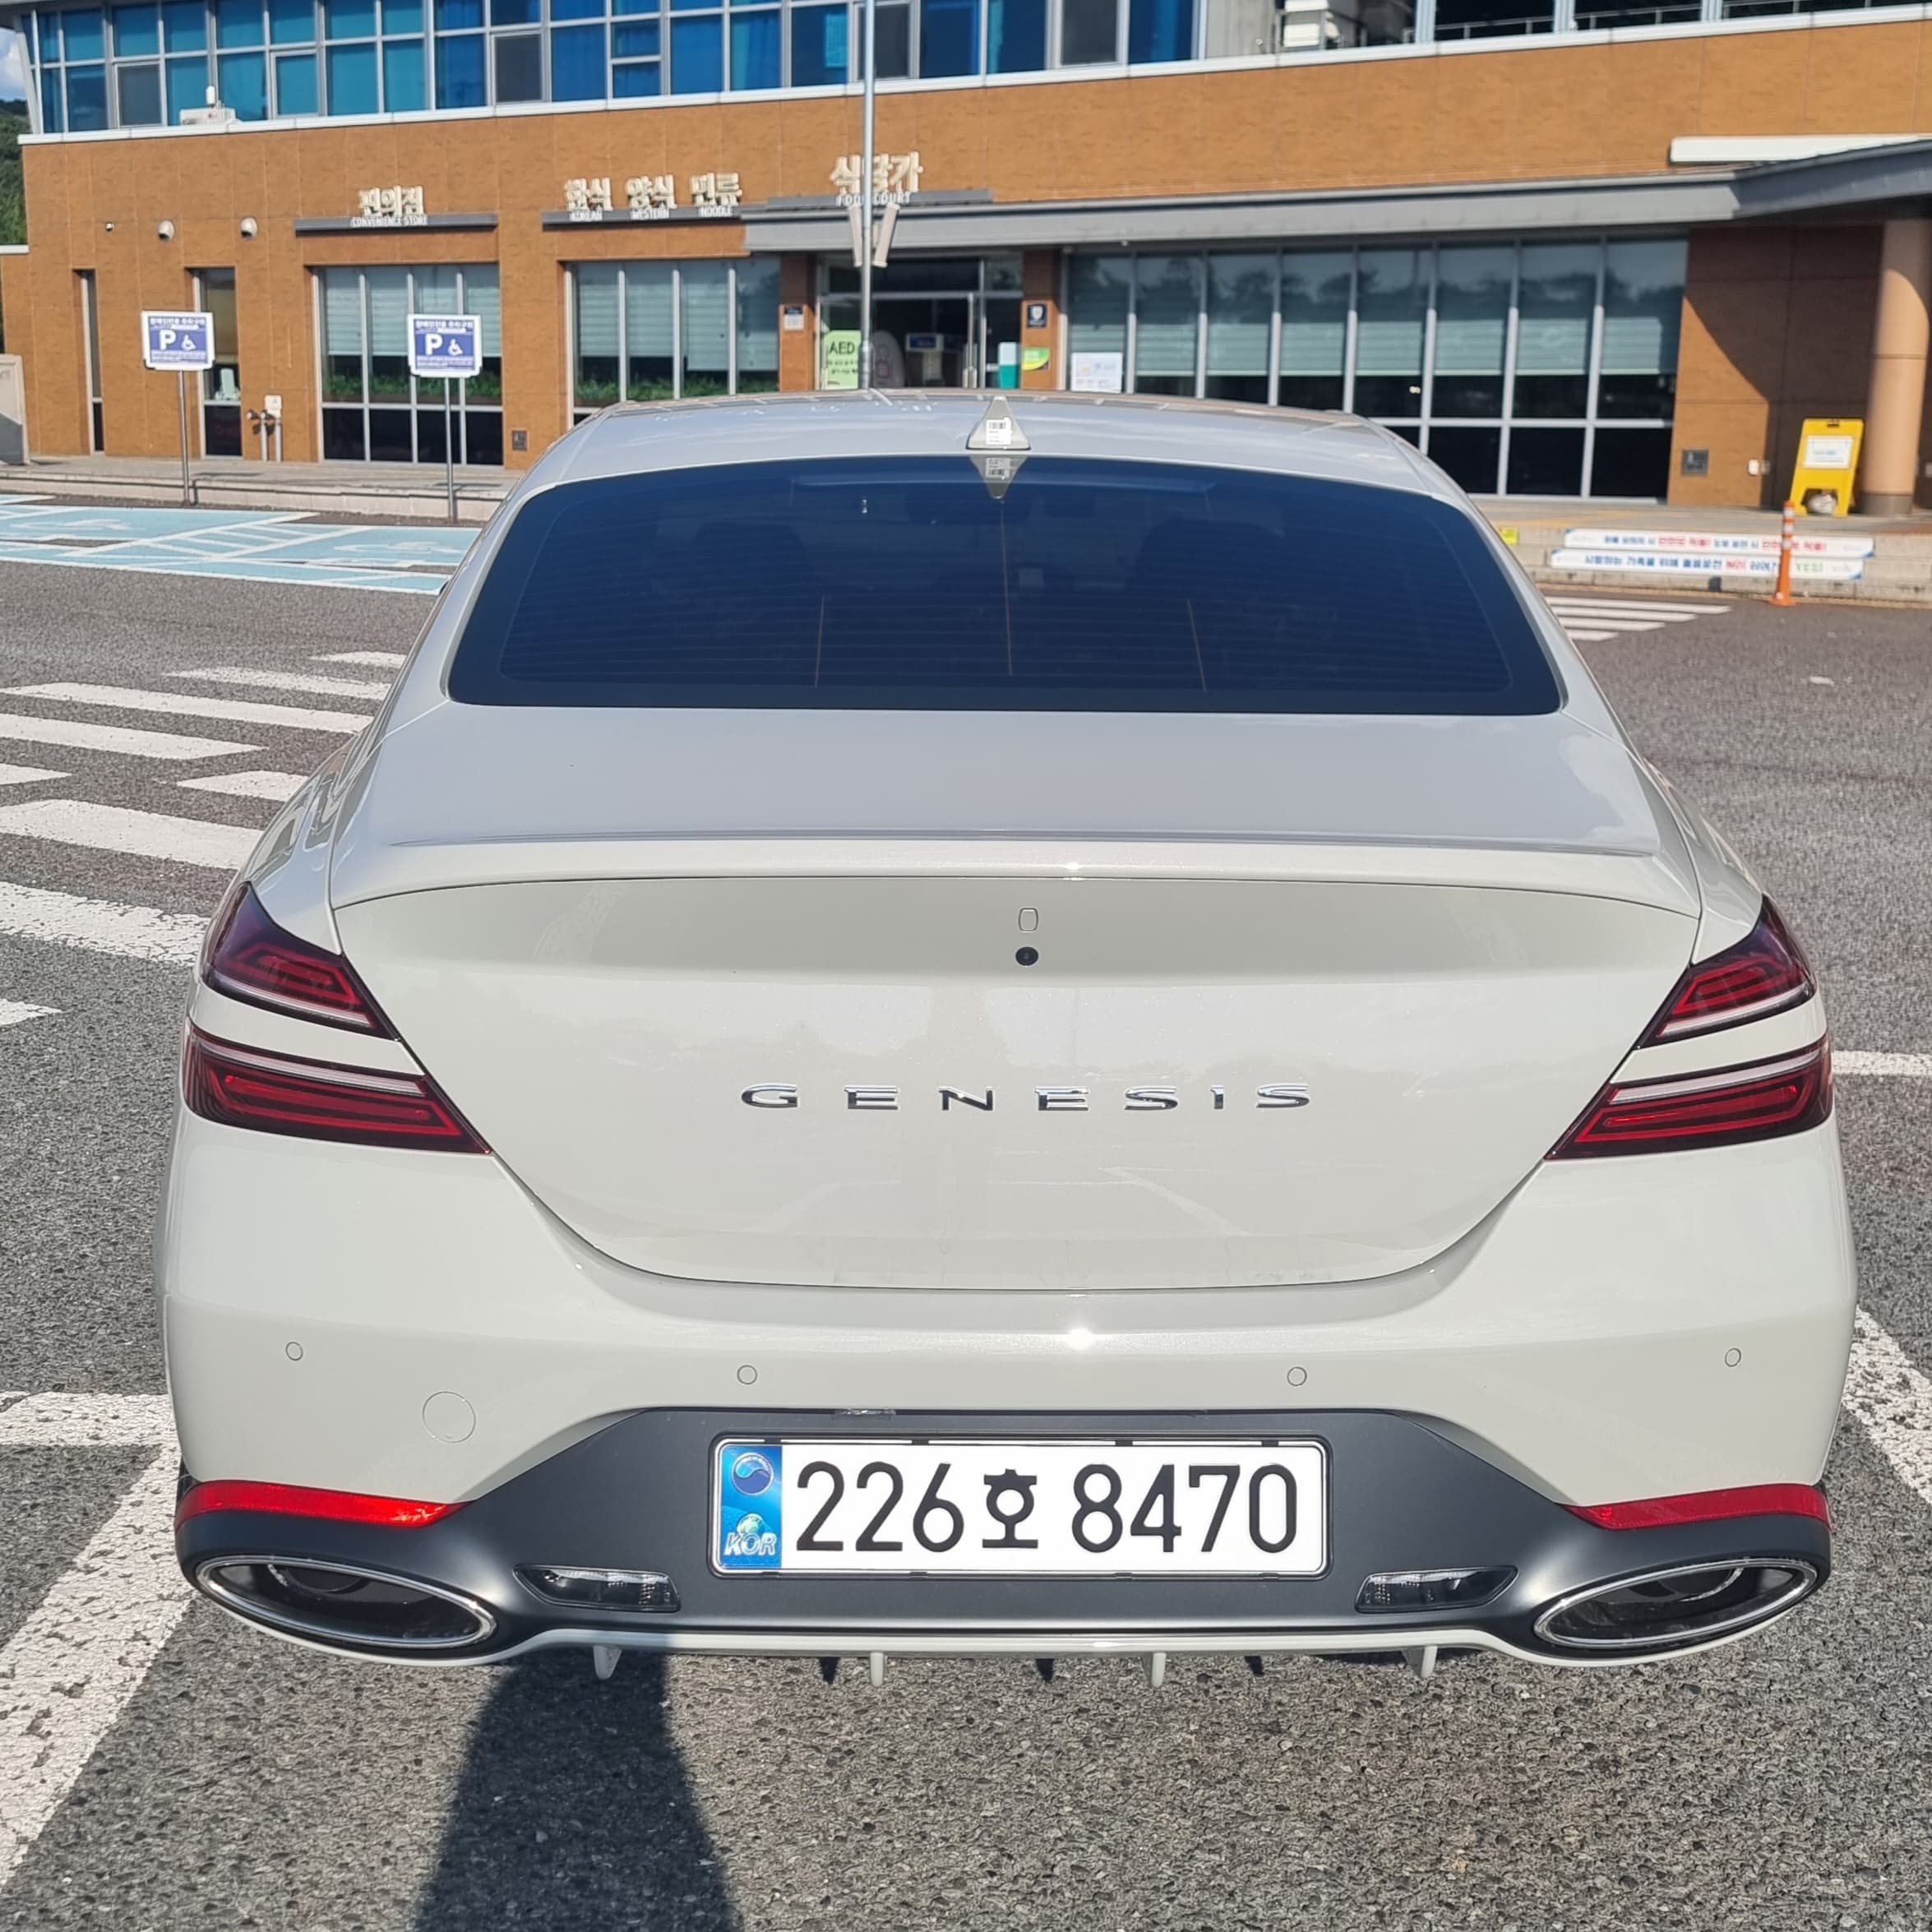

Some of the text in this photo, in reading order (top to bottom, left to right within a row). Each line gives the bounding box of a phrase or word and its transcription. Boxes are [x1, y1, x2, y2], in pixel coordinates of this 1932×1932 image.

[359, 186, 424, 218] 편의점
[565, 172, 742, 212] 한식 양식 면류
[835, 191, 912, 206] FOO COURT
[159, 329, 177, 350] P
[425, 333, 443, 355] P
[830, 341, 855, 354] AED
[741, 1083, 1310, 1111] GENESIS
[796, 1461, 1298, 1554] 226호 8470
[723, 1532, 778, 1555] KOR
